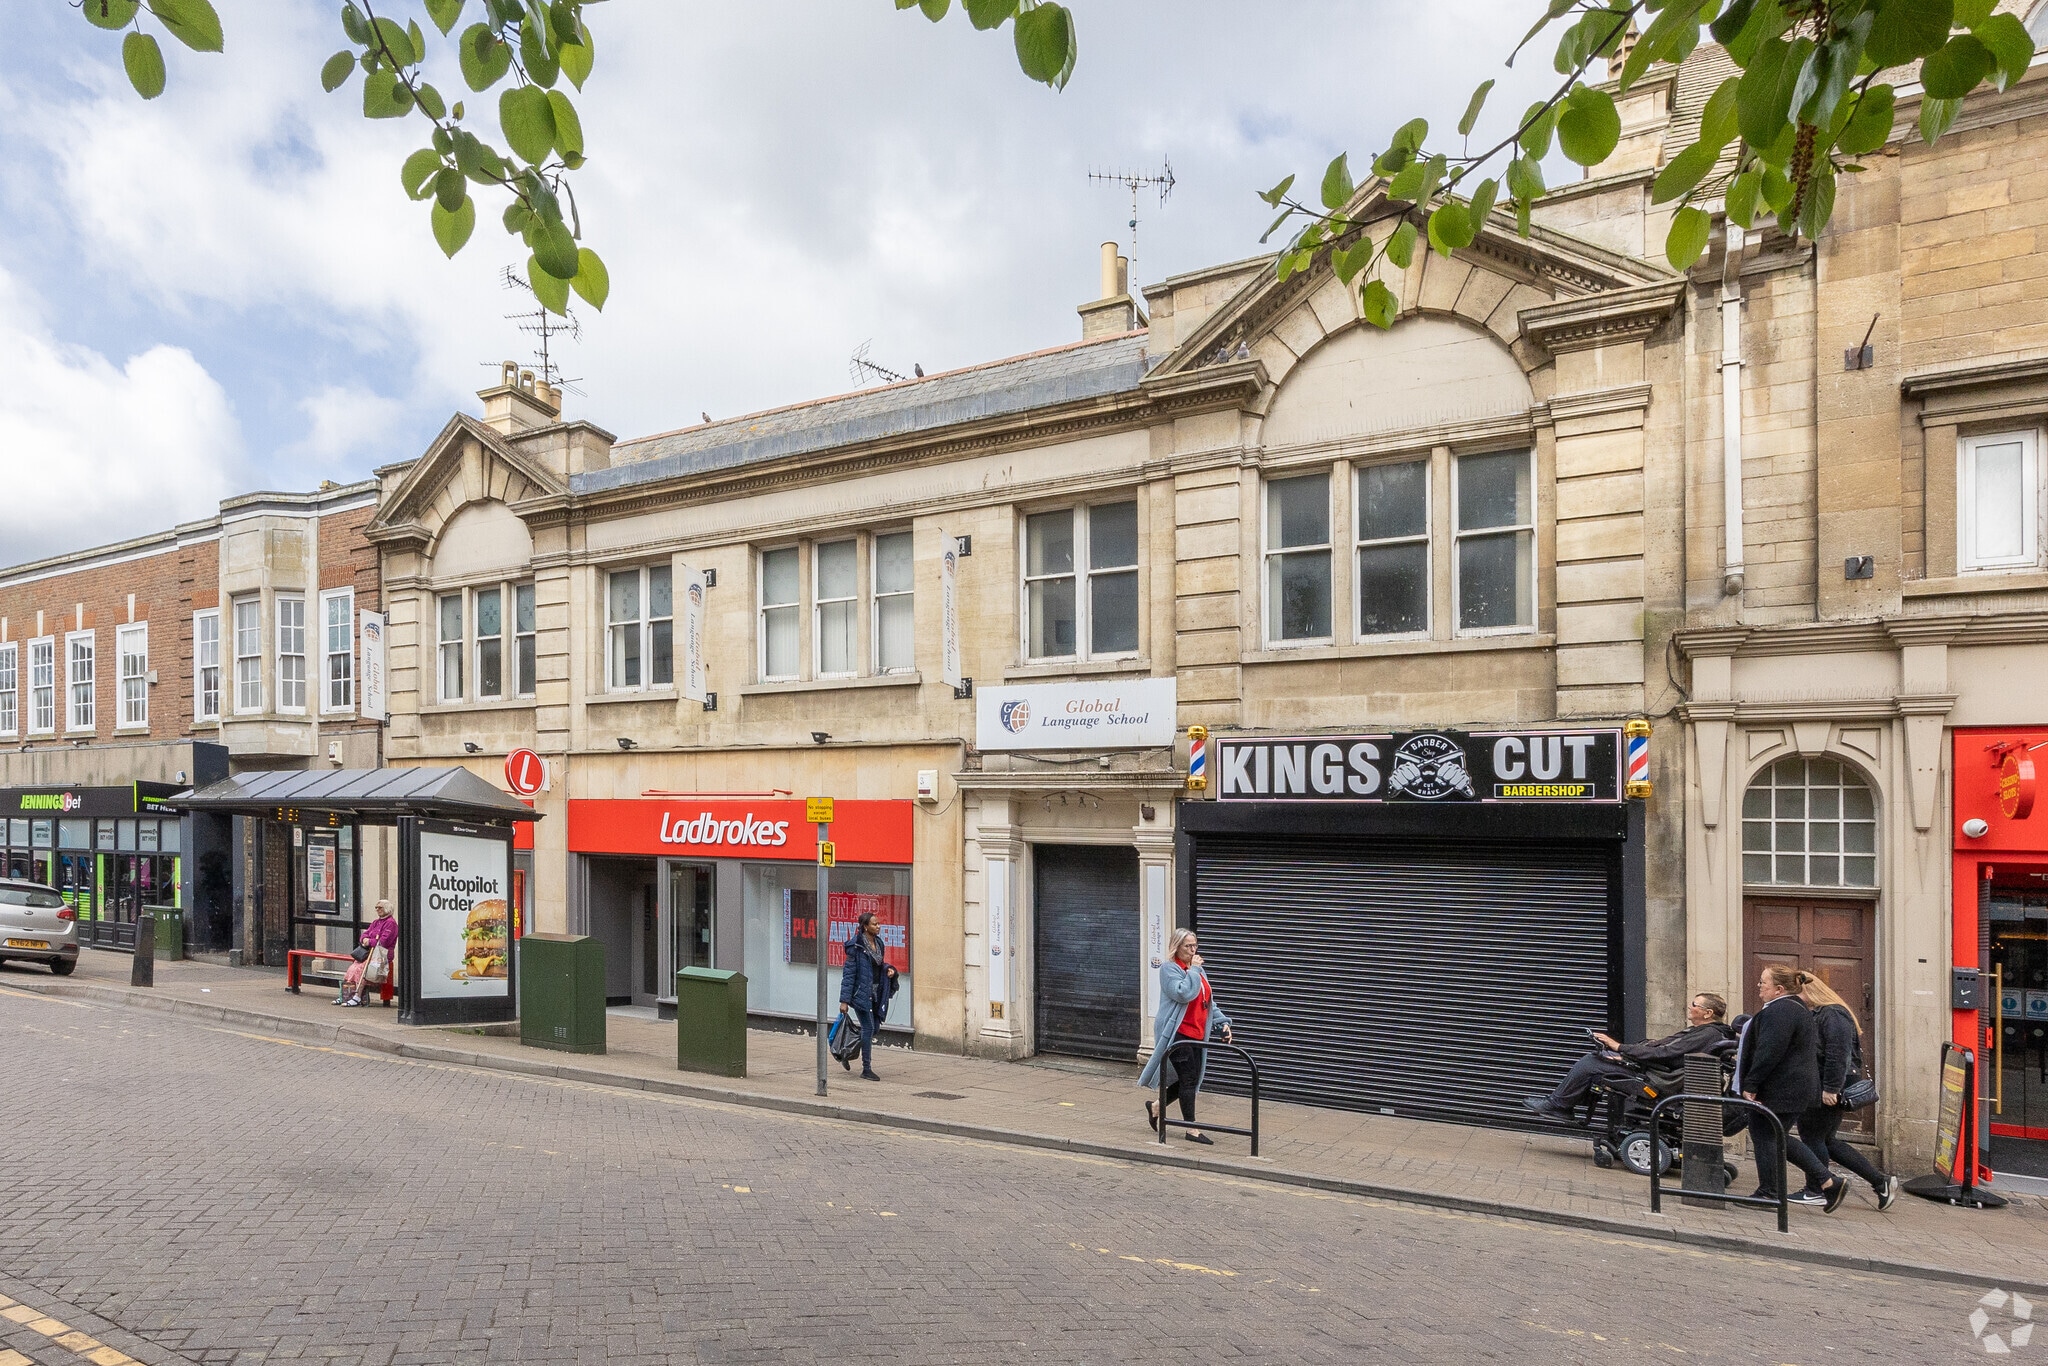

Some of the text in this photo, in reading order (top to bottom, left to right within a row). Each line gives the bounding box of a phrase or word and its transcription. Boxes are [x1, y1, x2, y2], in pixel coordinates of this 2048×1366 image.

[1065, 698, 1121, 714] Global
[1041, 713, 1149, 730] Language School
[1410, 738, 1448, 751] BARBER
[1421, 747, 1437, 758] Shop
[518, 754, 535, 790] L
[1222, 736, 1595, 795] KINGS CUT
[1502, 785, 1585, 796] BARBERSHOP
[2003, 786, 2017, 800] SLOTS
[146, 803, 159, 811] BET
[660, 812, 789, 846] Ladbrokes
[821, 843, 833, 864] H
[428, 854, 459, 873] The
[428, 873, 499, 897] Autopilot
[428, 893, 474, 912] Order
[829, 896, 848, 919] ON
[793, 917, 818, 938] PLA
[829, 920, 906, 948] ANYERE
